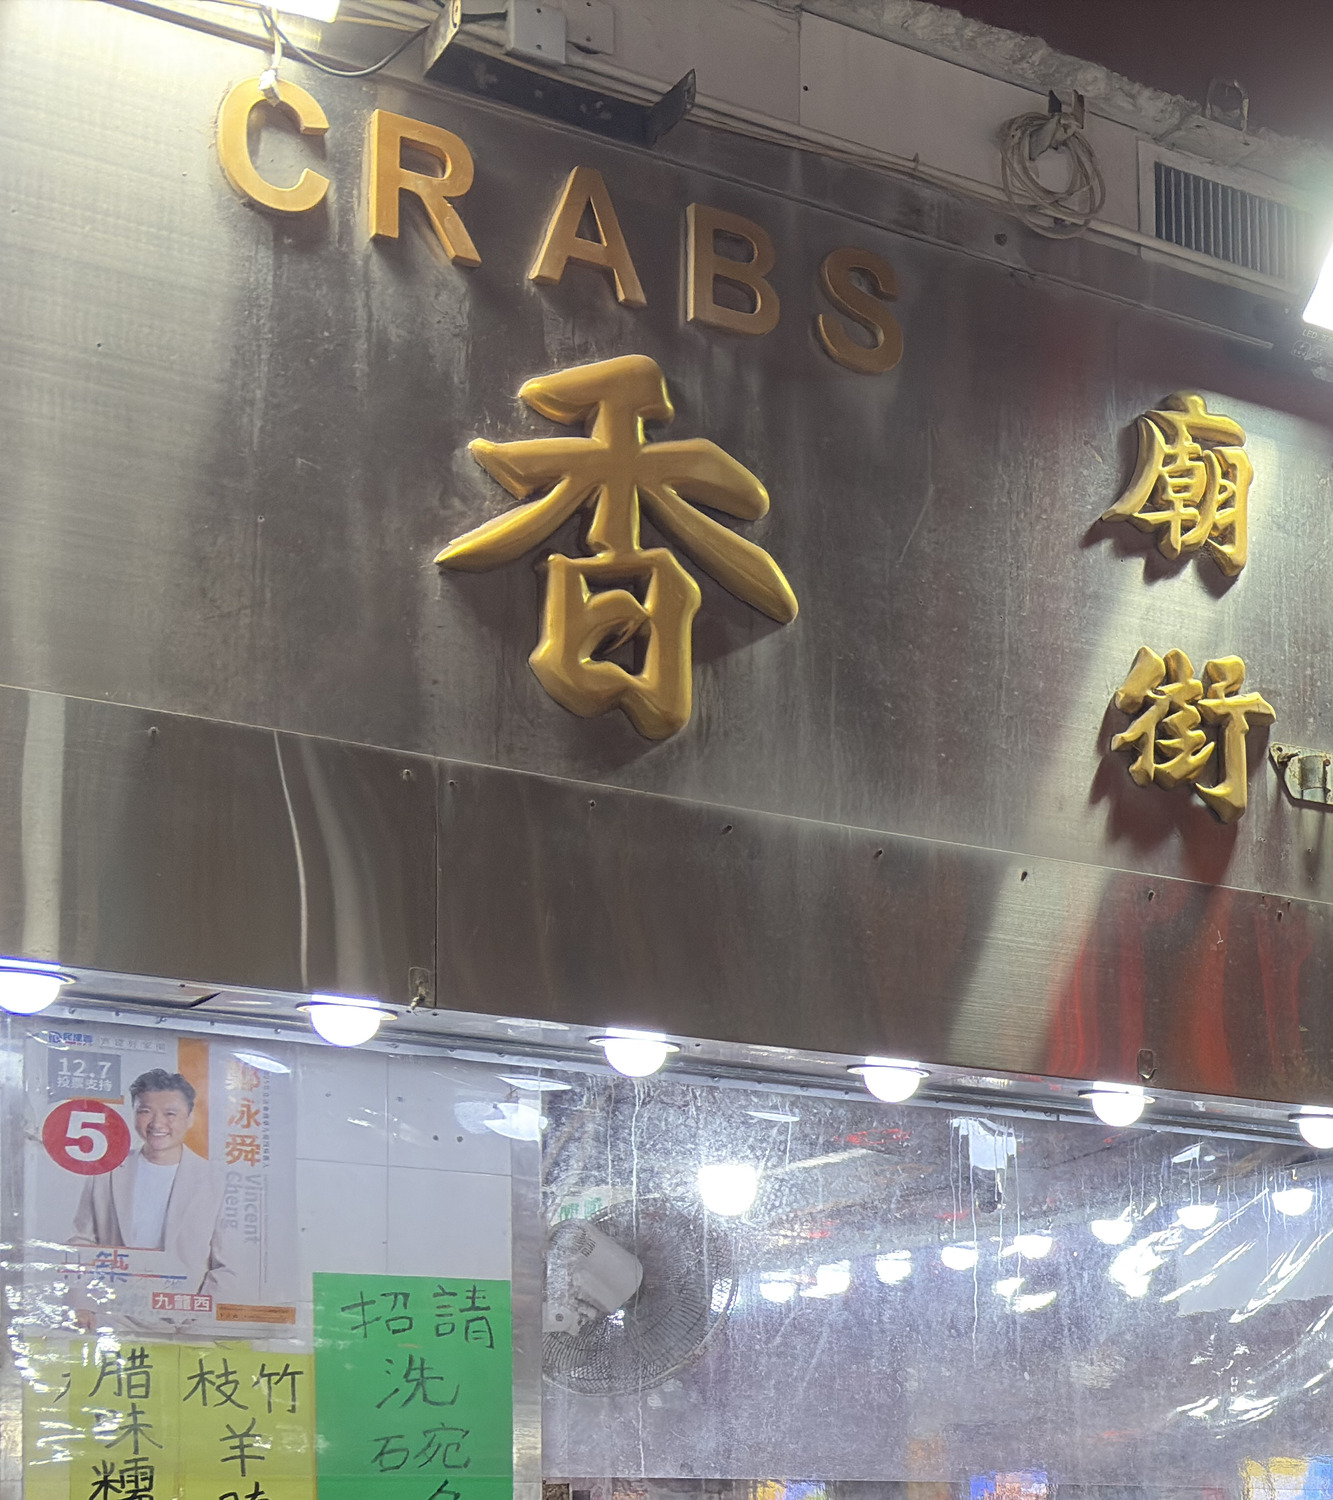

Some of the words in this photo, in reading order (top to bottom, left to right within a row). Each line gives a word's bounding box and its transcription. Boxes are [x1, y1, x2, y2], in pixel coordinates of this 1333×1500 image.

[216, 75, 904, 374] CRABS
[433, 354, 799, 738] 香
[1103, 393, 1275, 822] 廟街
[57, 1077, 113, 1092] 投票支持
[58, 1058, 112, 1079] 12.7
[65, 1111, 108, 1162] 5
[225, 1171, 242, 1229] Cheng
[243, 1175, 262, 1244] Vincent
[153, 1294, 211, 1311] 九龍西
[340, 1284, 495, 1350] 招請
[376, 1353, 459, 1409] 洗
